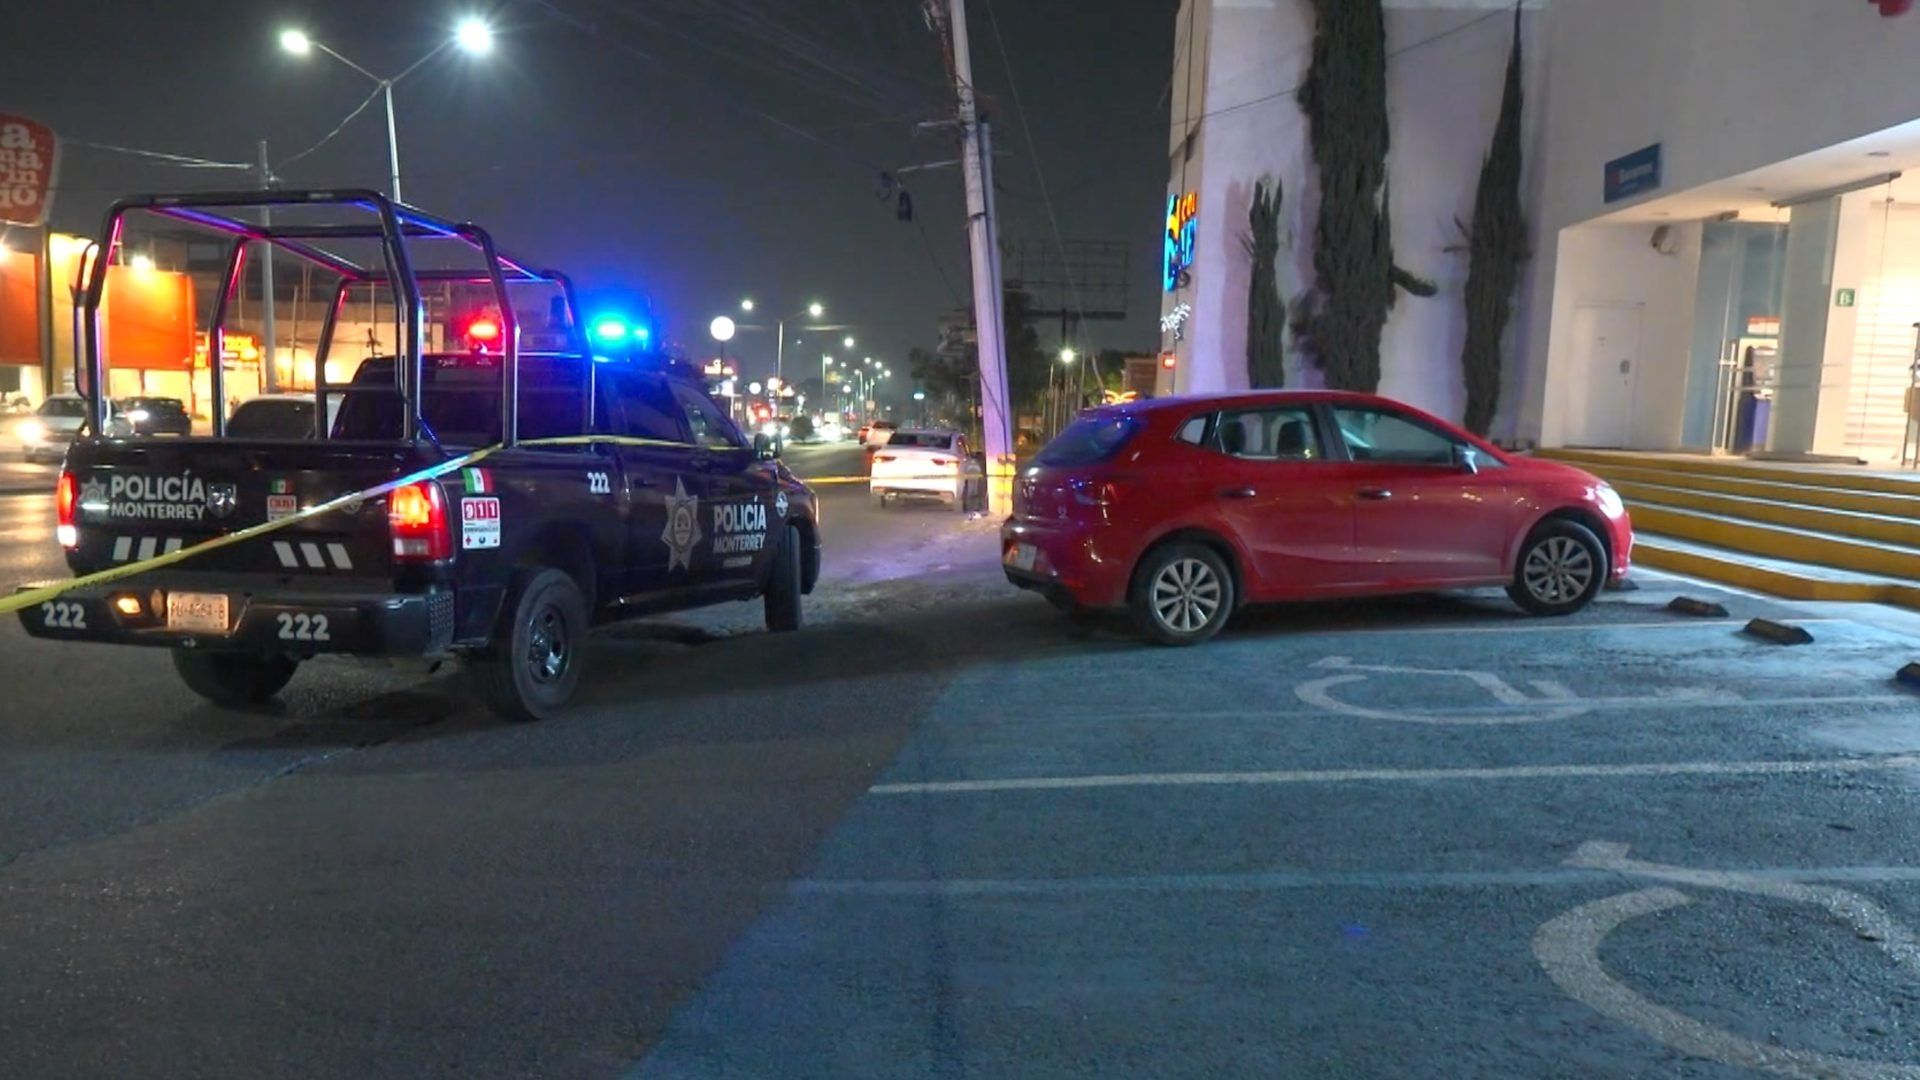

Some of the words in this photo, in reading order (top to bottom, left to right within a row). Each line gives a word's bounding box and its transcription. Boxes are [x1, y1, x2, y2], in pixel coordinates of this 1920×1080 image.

[111, 469, 206, 502] POLICÍA
[587, 471, 610, 494] 222
[110, 502, 205, 520] MONTERREY
[465, 503, 496, 519] 911
[713, 494, 767, 533] POLICÍA
[712, 532, 766, 555] MONTERREY
[42, 601, 87, 629] 222
[276, 612, 331, 641] 222
